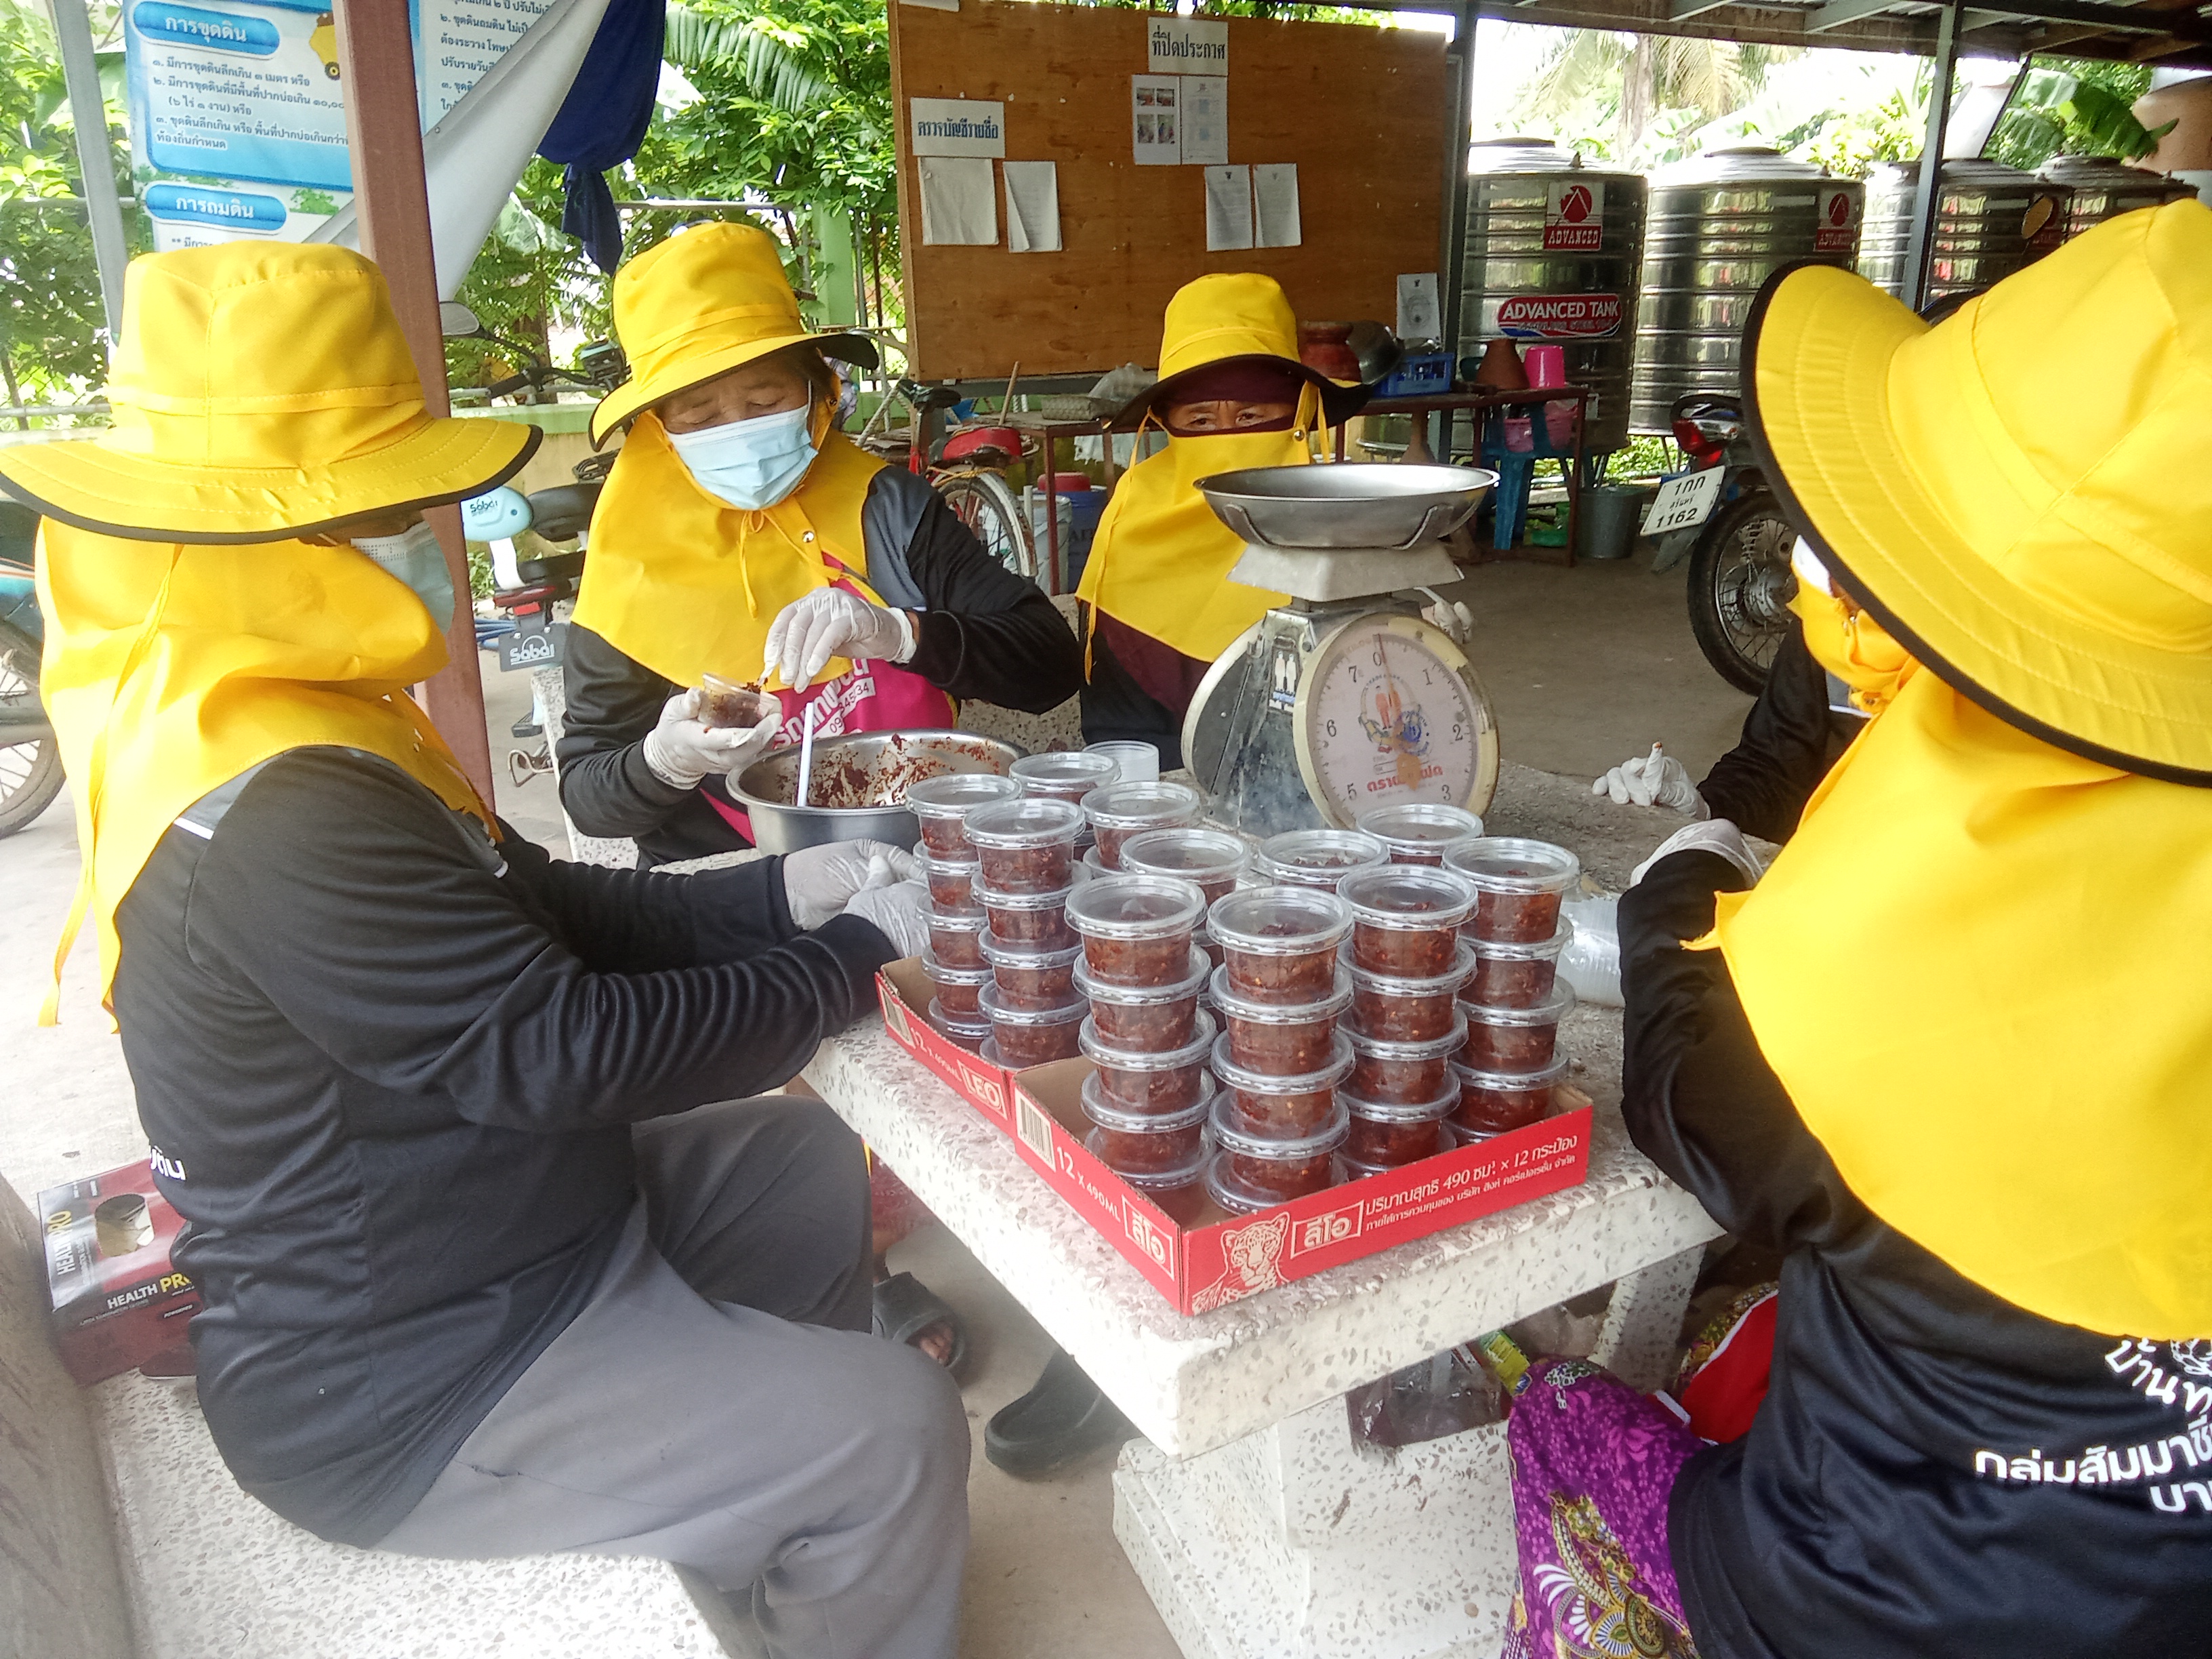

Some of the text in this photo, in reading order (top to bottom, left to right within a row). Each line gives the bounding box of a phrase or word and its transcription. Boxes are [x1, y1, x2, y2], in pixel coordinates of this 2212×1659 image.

[165, 16, 247, 43] การขุดดิน
[1152, 25, 1225, 59] ที่ปิดประกาศ
[265, 73, 288, 83] เมตร
[291, 74, 310, 86] หรือ
[232, 103, 251, 115] หรือ
[918, 116, 998, 139] ตรวจบัญชีรายชื่อ
[157, 130, 226, 148] ท้องถิ่นกำหนด
[176, 197, 254, 219] การถมดิน
[1548, 229, 1598, 244] ADVANCED
[1502, 301, 1618, 319] ADVANCED TANK
[1675, 476, 1706, 496] 1กก
[1656, 508, 1698, 528] 1162
[510, 643, 554, 661] Sabai
[1348, 665, 1357, 682] 7
[1422, 668, 1433, 685] 1
[1326, 720, 1336, 737] 6
[1452, 724, 1463, 741] 2
[1347, 783, 1357, 800] 5
[1441, 784, 1451, 800] 3
[962, 1066, 1002, 1109] LEO
[1057, 1146, 1076, 1179] 12
[1086, 1183, 1121, 1223] 490ML
[1366, 1178, 1440, 1216] ปริมาณสุทธิ
[1443, 1169, 1471, 1190] 490
[1514, 1150, 1529, 1168] 12
[1132, 1210, 1166, 1265] ลีโอ
[1304, 1212, 1352, 1249] ลีโอ
[106, 1283, 158, 1309] HEALTH
